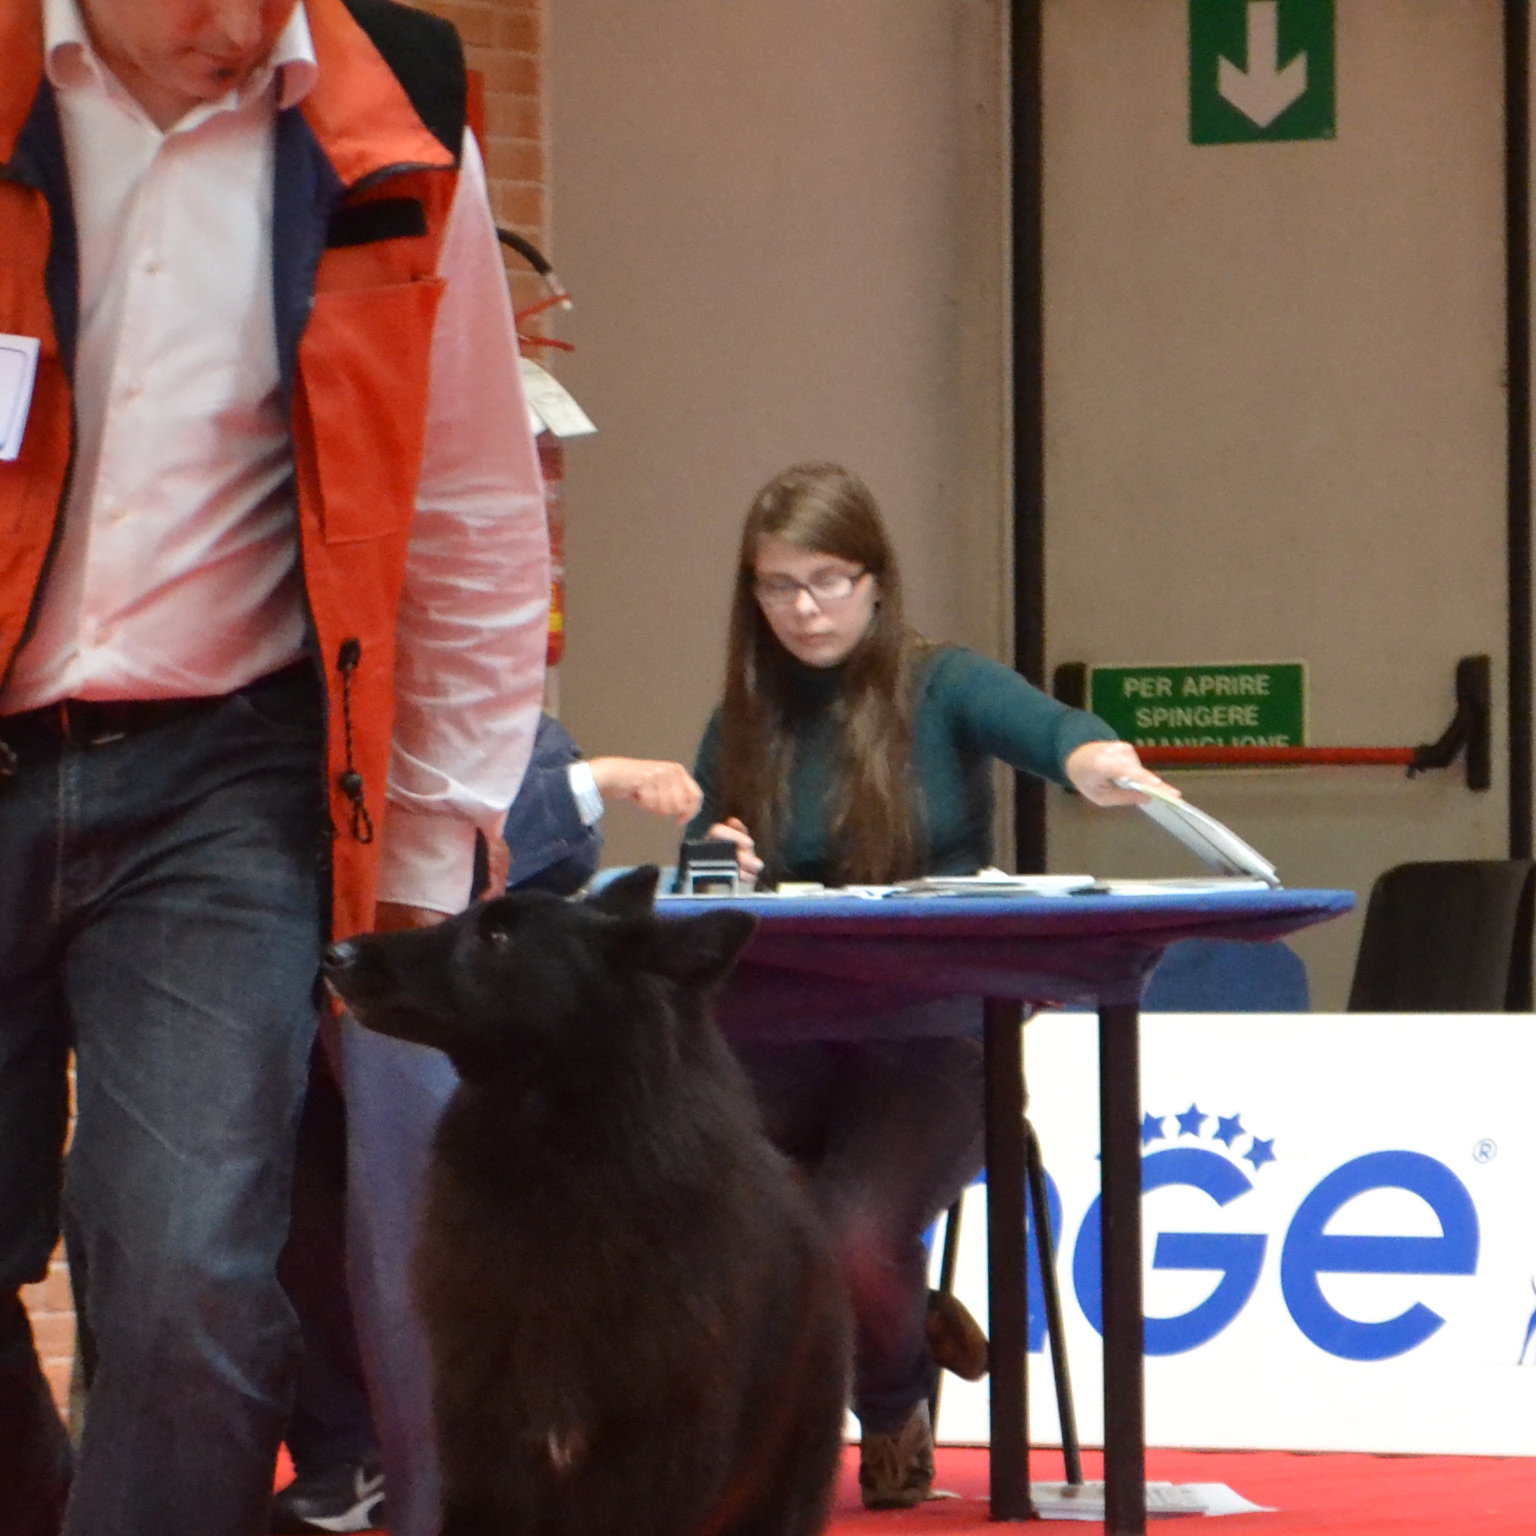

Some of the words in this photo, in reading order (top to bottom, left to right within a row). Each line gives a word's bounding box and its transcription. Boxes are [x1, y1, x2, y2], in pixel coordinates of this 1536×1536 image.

[1123, 676, 1173, 698] PER
[1181, 674, 1270, 697] APRIRE
[1135, 705, 1260, 728] SPINGERE
